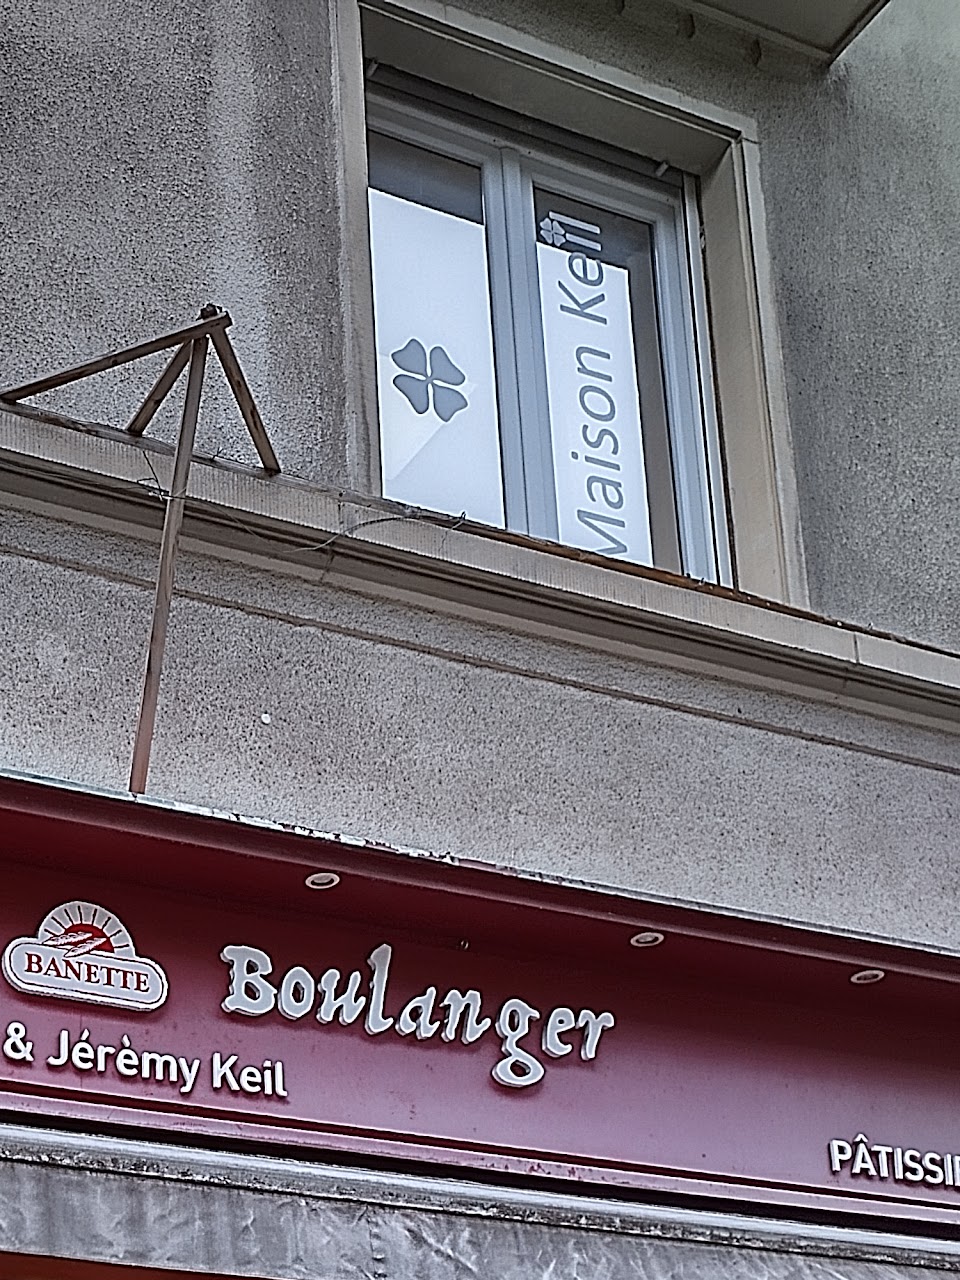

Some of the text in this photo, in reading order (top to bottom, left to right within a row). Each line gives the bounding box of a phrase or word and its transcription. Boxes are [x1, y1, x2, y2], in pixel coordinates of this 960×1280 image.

[541, 211, 628, 557] Maison Keil
[24, 952, 150, 992] BANETTE
[220, 943, 615, 1088] Boulanger
[3, 1022, 34, 1063] &
[47, 1028, 200, 1095] Jérèmy
[212, 1052, 288, 1098] Keil
